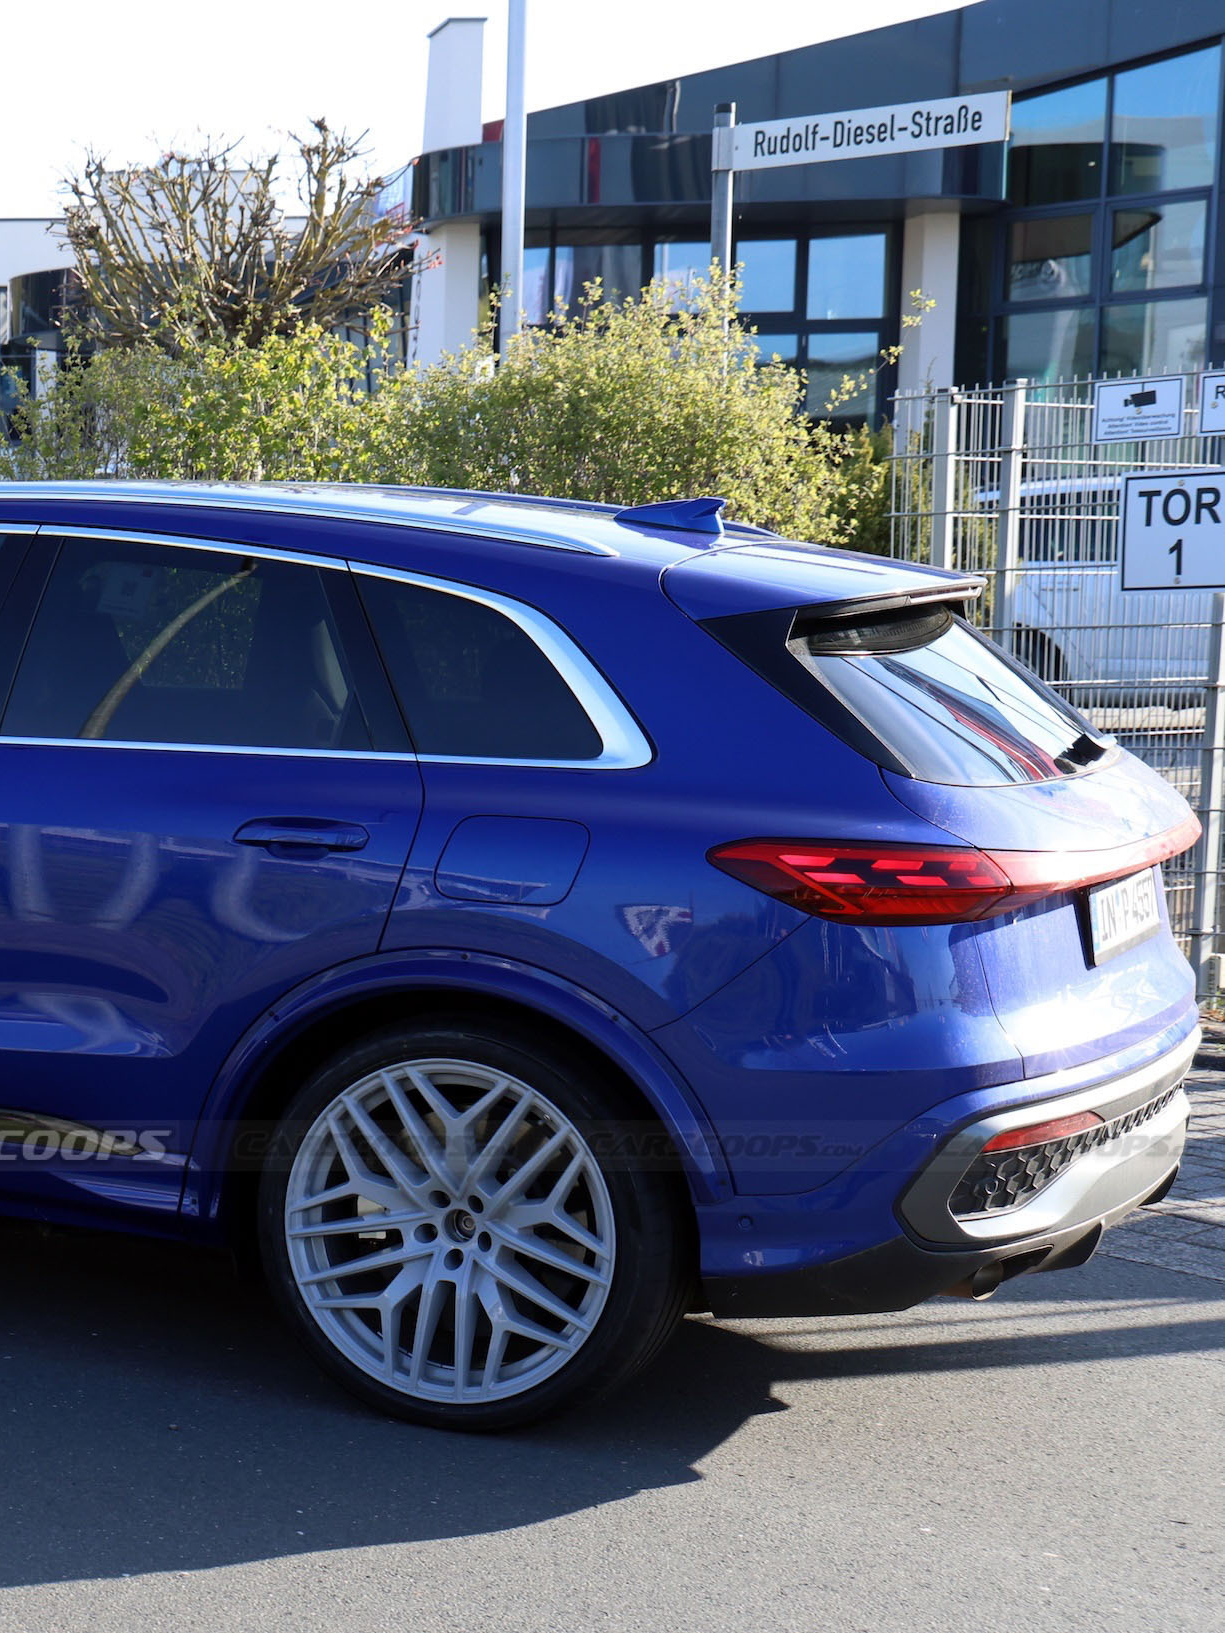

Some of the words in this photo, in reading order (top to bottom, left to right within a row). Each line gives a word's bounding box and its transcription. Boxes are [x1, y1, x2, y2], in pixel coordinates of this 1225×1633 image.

[753, 104, 983, 158] Rudolf-Diesel-Straße
[1138, 487, 1222, 527] TOR
[1168, 538, 1183, 576] 1
